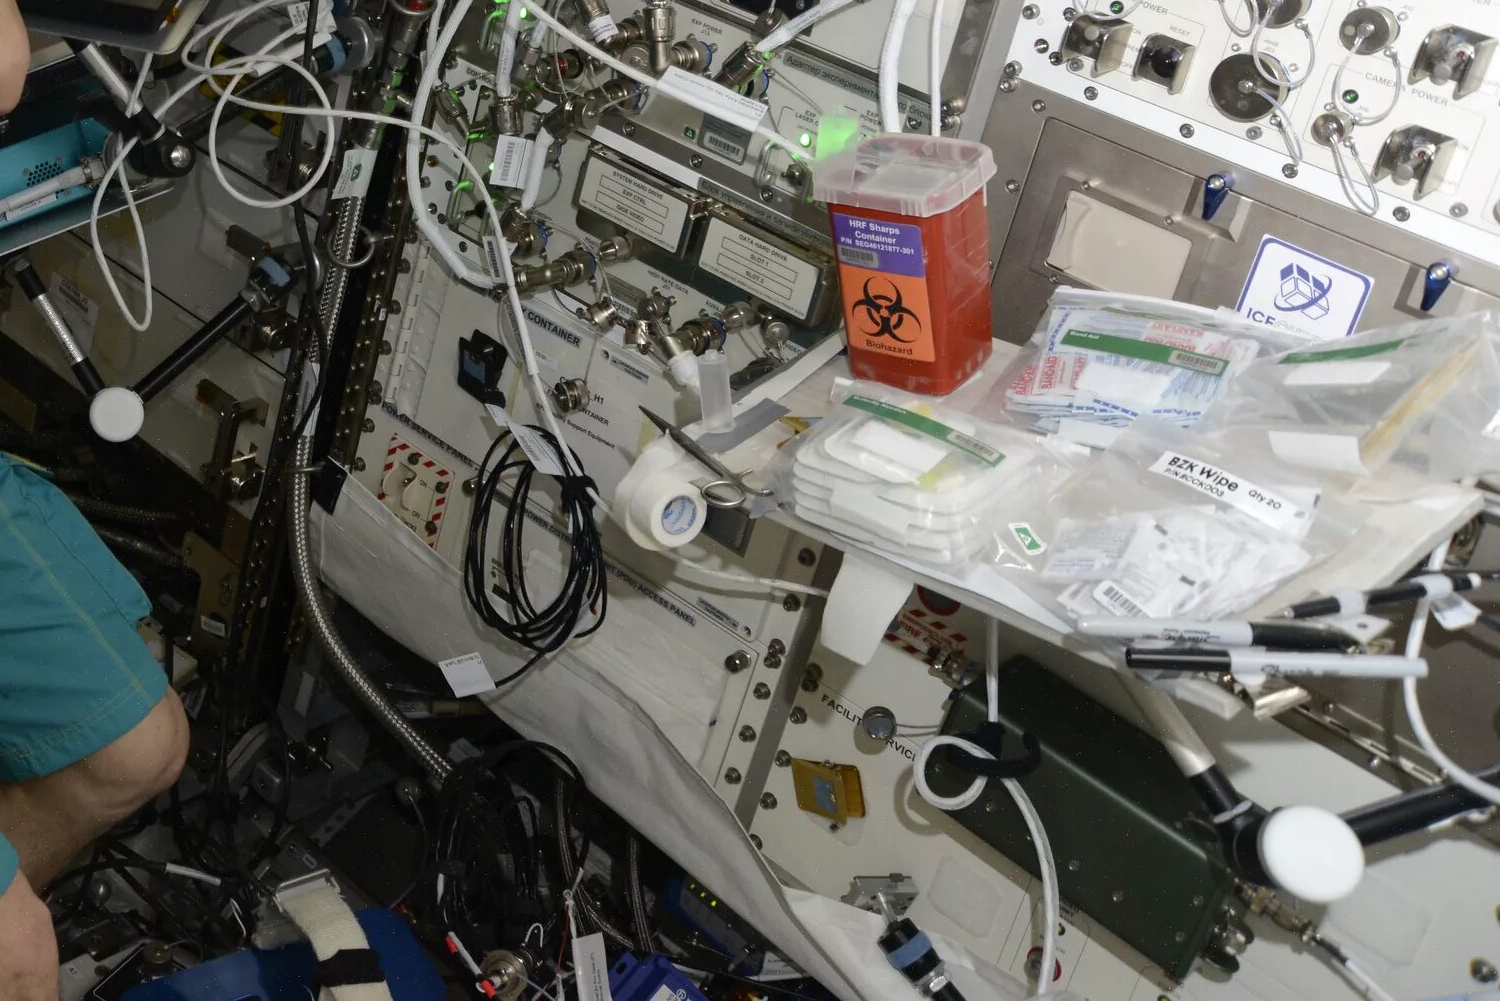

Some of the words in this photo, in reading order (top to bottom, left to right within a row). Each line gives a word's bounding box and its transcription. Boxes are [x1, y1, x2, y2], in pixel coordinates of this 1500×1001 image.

[1140, 1, 1168, 15] OWER
[691, 18, 701, 26] EXP
[702, 22, 723, 35] POWER
[1169, 25, 1191, 37] RESET
[786, 54, 821, 77] Адаптер
[1411, 88, 1449, 107] POWER
[795, 112, 814, 124] LASER
[804, 109, 817, 118] EXP
[859, 114, 882, 126] POWER
[612, 170, 633, 185] SYSTEM
[632, 179, 648, 193] HARD
[646, 185, 663, 200] DRIVE
[622, 189, 634, 199] EXP
[628, 210, 645, 223] VIDEO
[849, 219, 867, 229] HRF
[869, 223, 900, 235] Sharps
[840, 236, 853, 245] P/N
[855, 230, 897, 245] Container
[739, 234, 756, 247] DATA
[754, 241, 772, 255] HARD
[769, 248, 788, 263] DRIVE
[750, 254, 765, 266] SLOT
[647, 269, 663, 281] HIGH
[660, 275, 676, 287] RATE
[674, 281, 689, 295] DATA
[527, 311, 582, 348] CONTAINER
[1070, 330, 1088, 339] Band
[866, 338, 913, 356] Biohazard
[381, 403, 411, 428] POWER
[410, 420, 447, 450] SERVICE
[444, 443, 474, 469] PANEL
[566, 419, 587, 436] Support
[586, 430, 616, 450] Equipment
[1163, 467, 1181, 478] P/N
[1167, 456, 1199, 473] BZK
[1199, 466, 1239, 492] Wipe
[419, 479, 428, 488] ON
[1248, 489, 1266, 504] Qty
[1266, 498, 1282, 510] 20
[411, 510, 421, 519] OFF
[524, 508, 552, 529] POWER
[616, 568, 637, 589] (PDU)
[636, 582, 671, 609] ACCESS
[668, 604, 698, 627] PANEL
